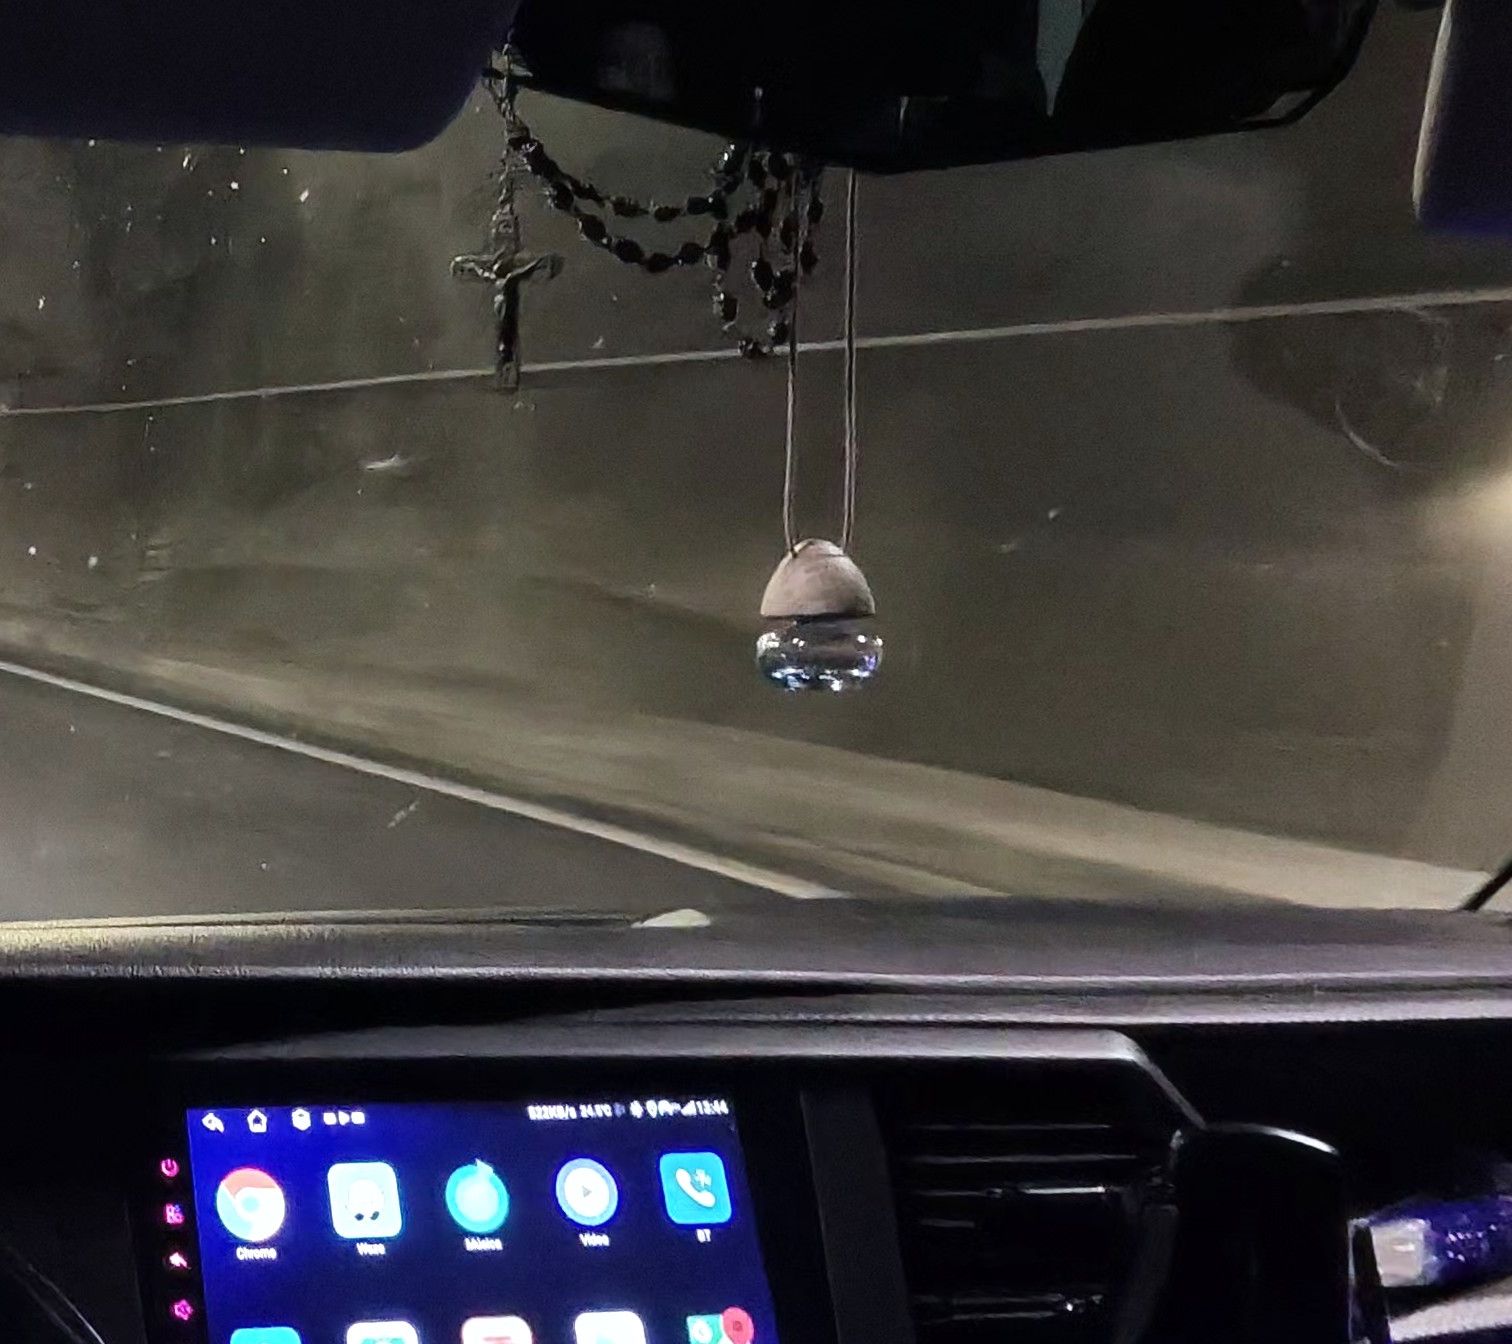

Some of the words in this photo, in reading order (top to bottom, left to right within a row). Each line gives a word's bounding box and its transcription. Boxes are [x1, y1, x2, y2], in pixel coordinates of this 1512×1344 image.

[696, 1229, 711, 1243] BT
[236, 1246, 276, 1260] Chrome
[356, 1242, 386, 1255] Waze
